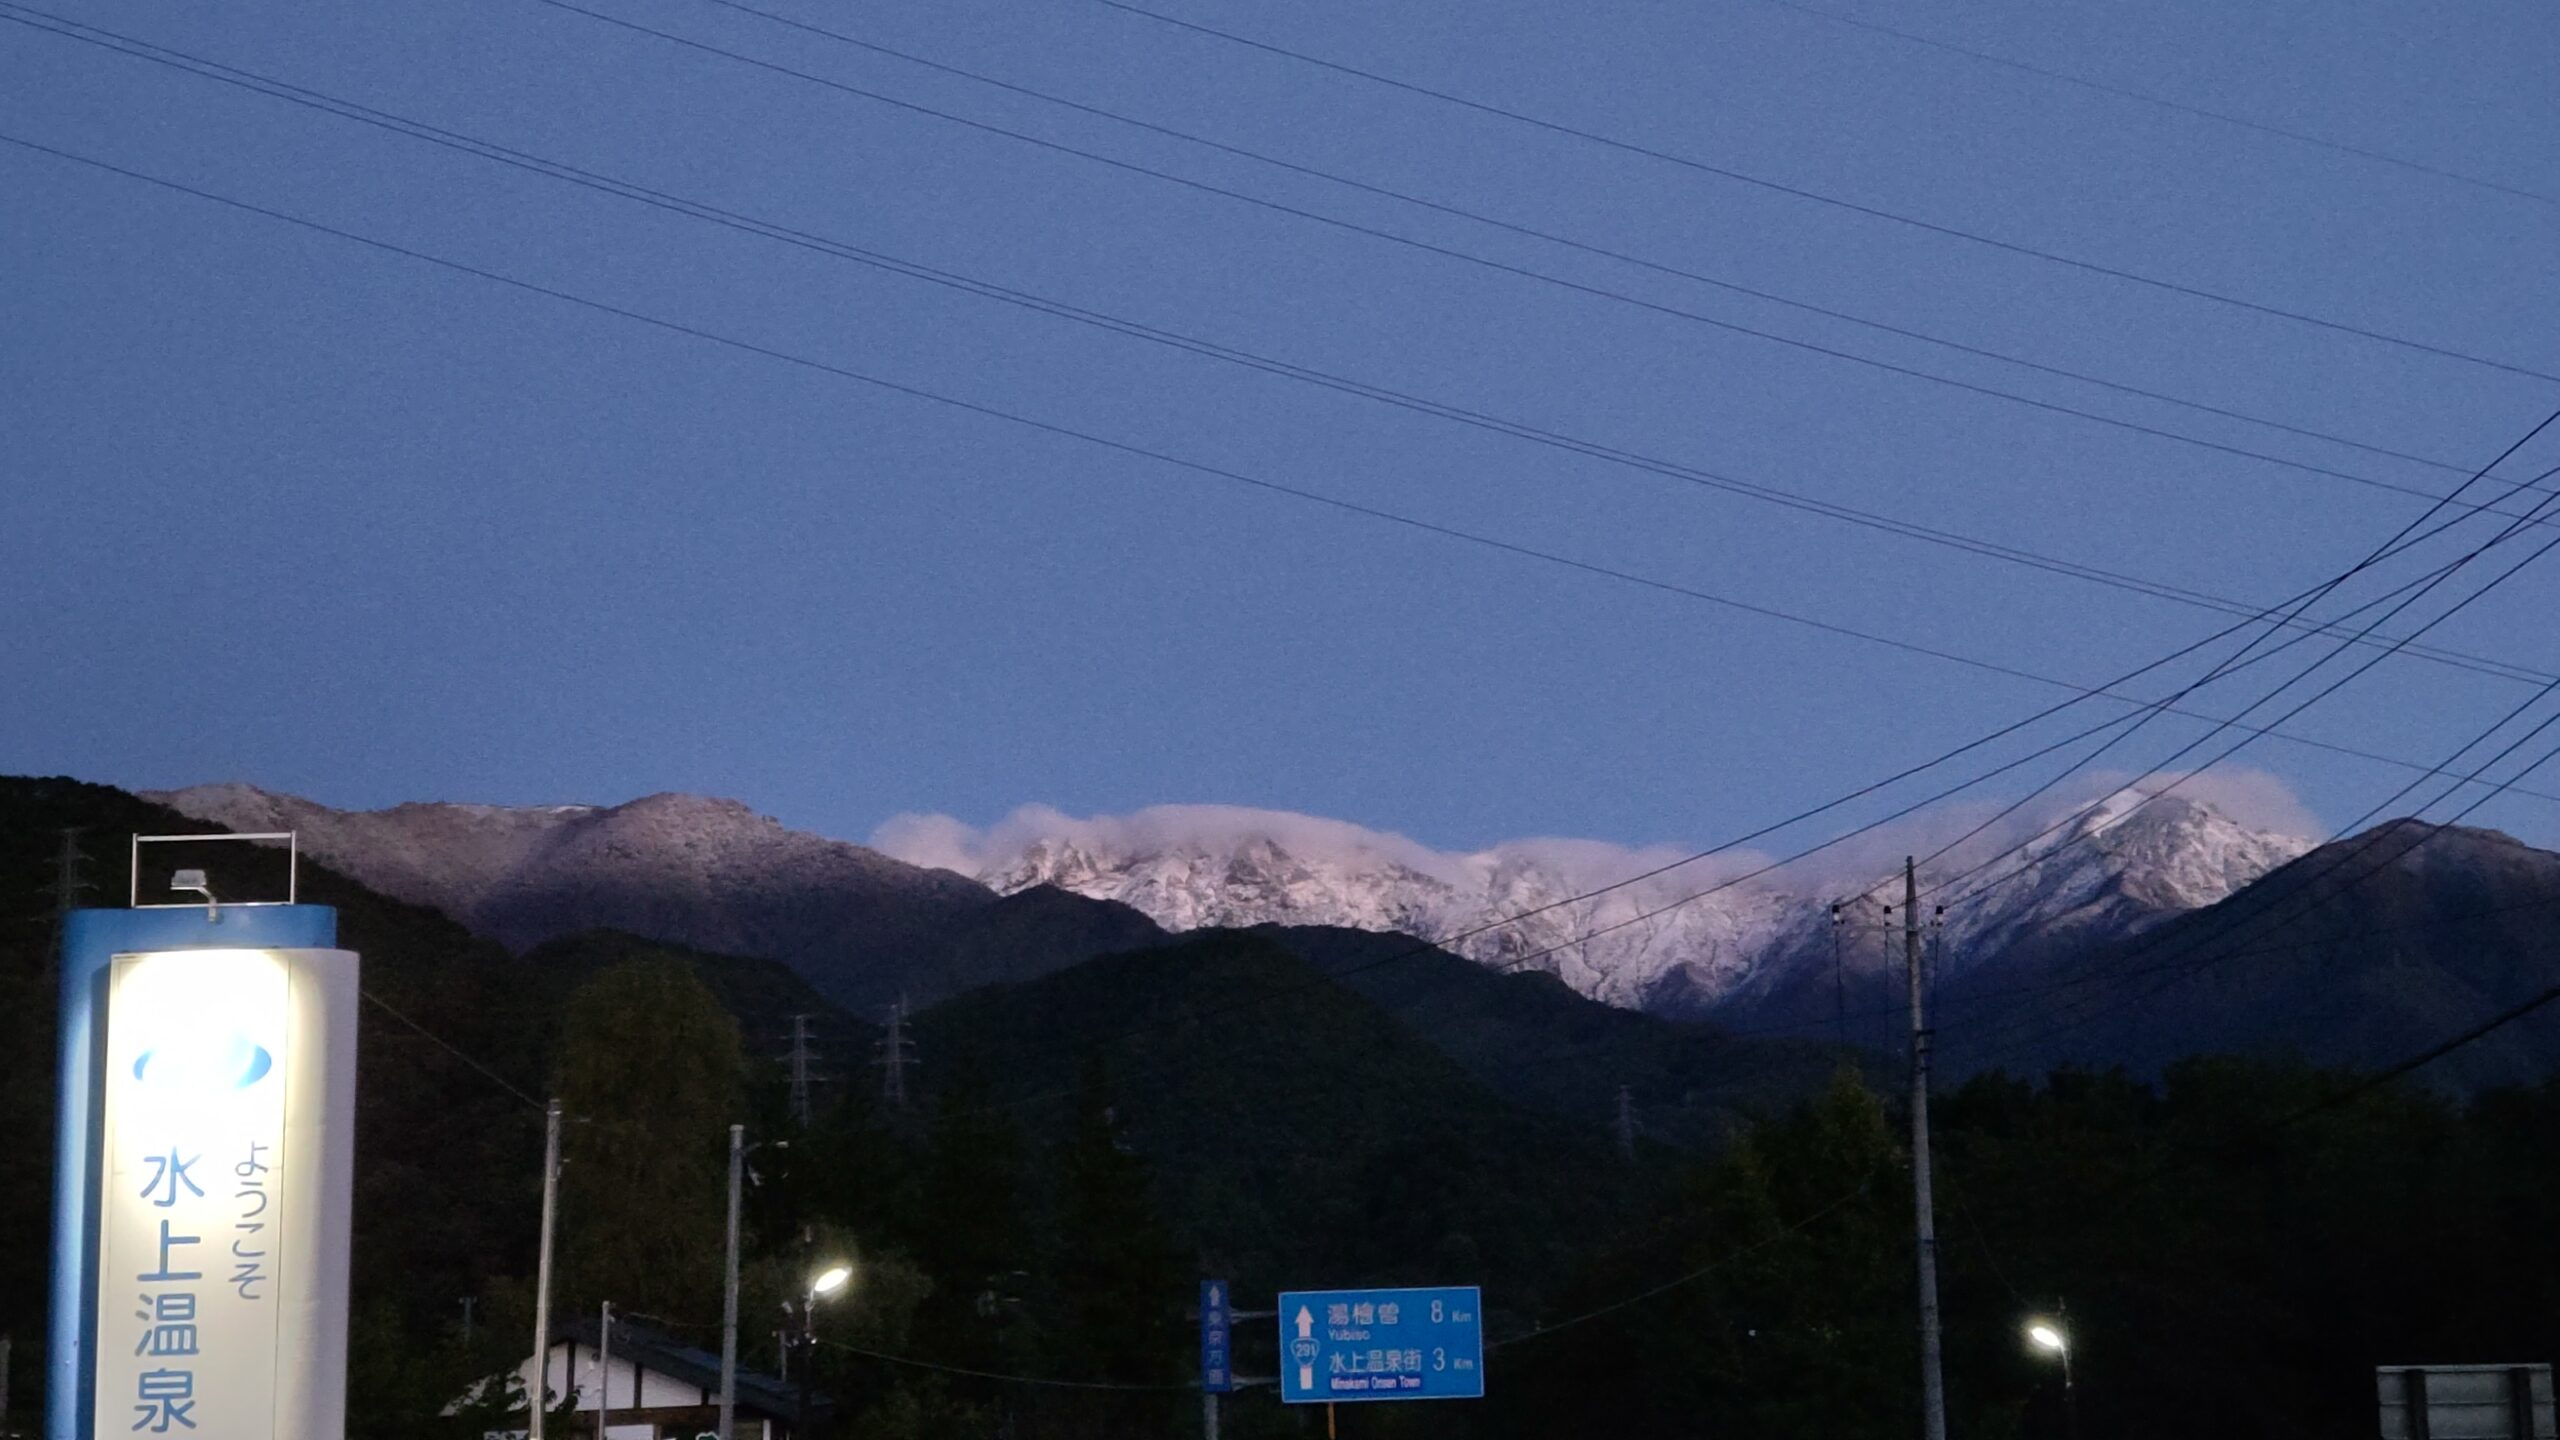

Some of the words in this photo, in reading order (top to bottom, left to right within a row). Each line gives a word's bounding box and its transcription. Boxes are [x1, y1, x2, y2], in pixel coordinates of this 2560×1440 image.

[228, 1139, 269, 1300] ようこそ
[132, 1145, 205, 1433] 水上温泉
[1431, 1299, 1443, 1323] 8
[1327, 1330, 1371, 1341] Yubiso
[1295, 1343, 1317, 1357] 291
[1328, 1349, 1423, 1373] 水上温泉街
[1432, 1347, 1445, 1372] 3
[1331, 1377, 1369, 1390] Minakami
[1399, 1375, 1421, 1388] Town
